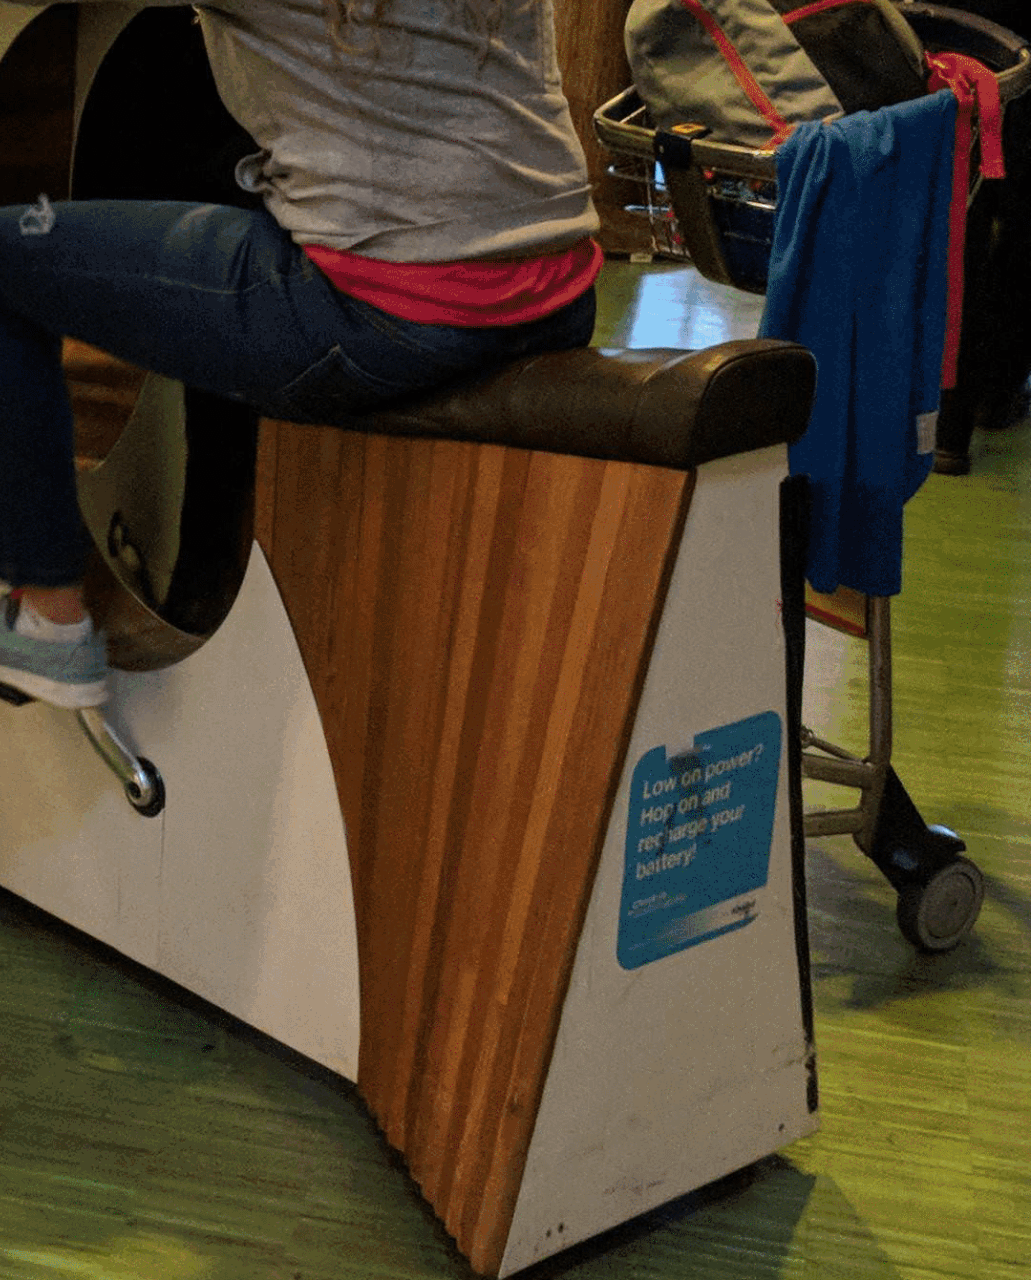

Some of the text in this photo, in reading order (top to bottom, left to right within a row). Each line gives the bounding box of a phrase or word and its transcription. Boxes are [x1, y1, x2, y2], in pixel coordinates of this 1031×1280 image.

[642, 742, 765, 801] Low on power?
[637, 803, 747, 853] recarge your
[639, 780, 732, 828] Hop on and
[636, 841, 698, 881] battery!
